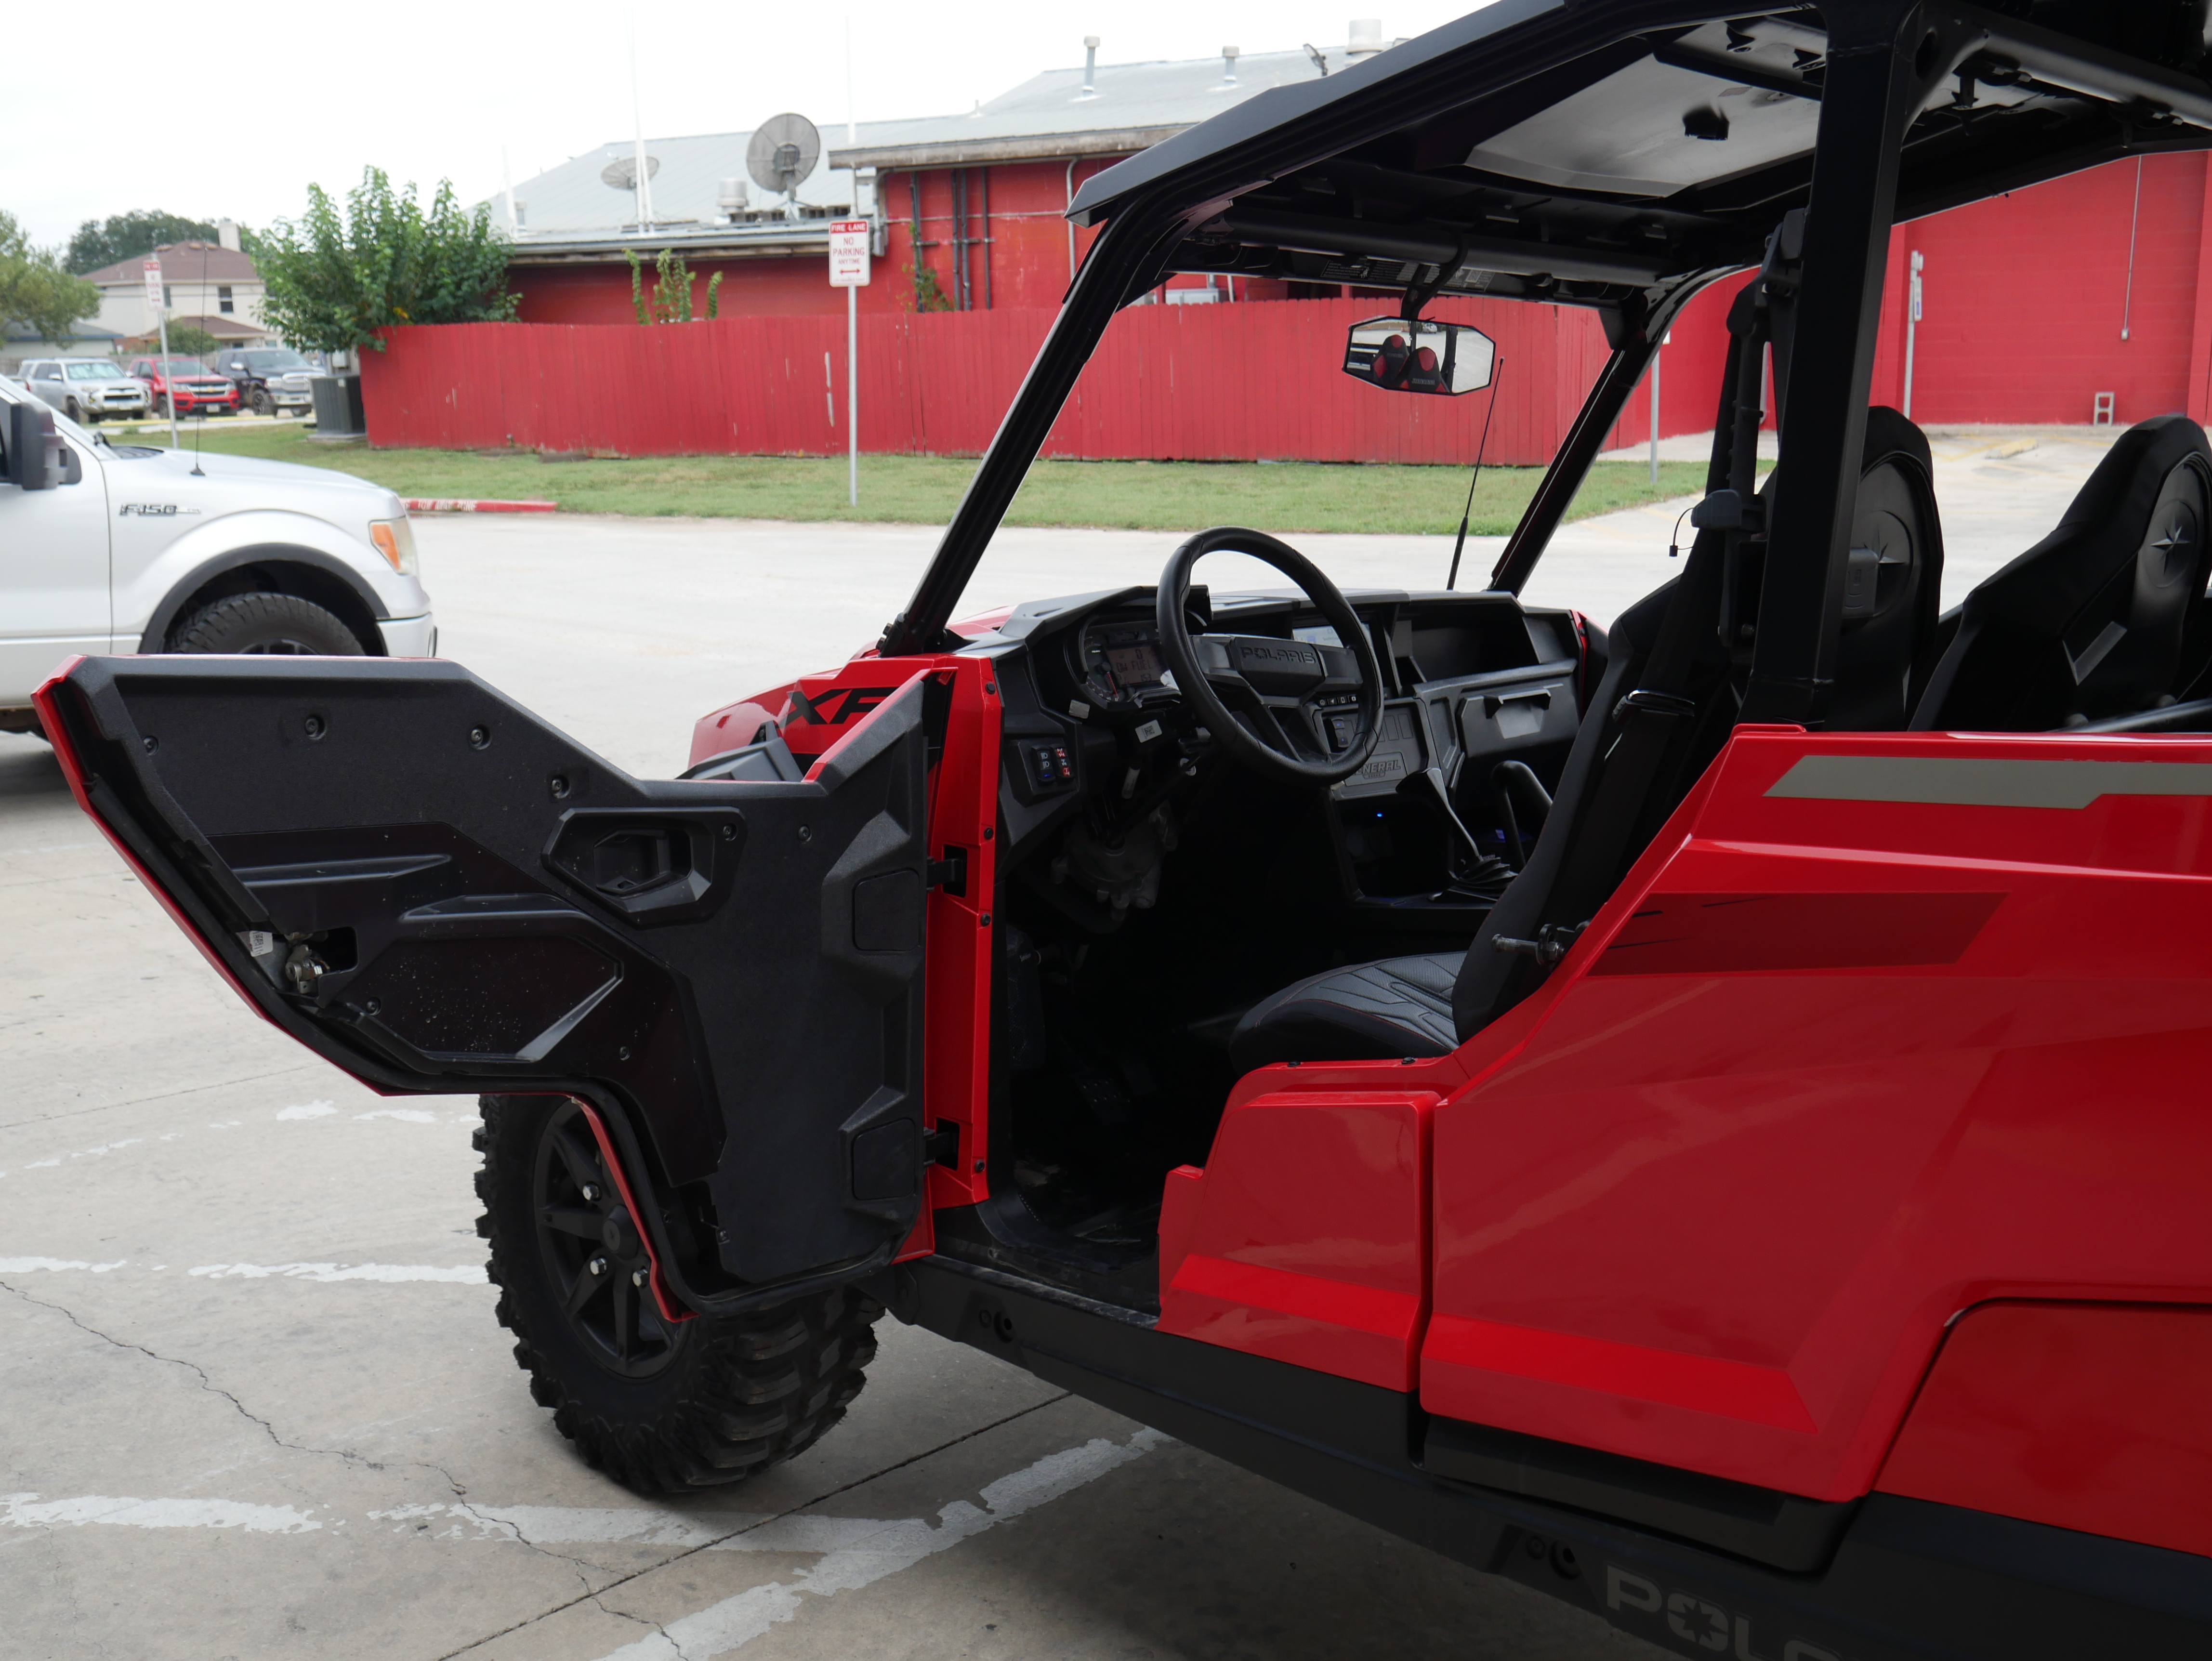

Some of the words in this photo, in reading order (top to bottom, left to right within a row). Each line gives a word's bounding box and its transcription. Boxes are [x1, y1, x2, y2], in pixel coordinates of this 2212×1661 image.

[831, 224, 845, 232] FIRE
[848, 223, 866, 231] LANE
[843, 237, 854, 245] NO
[833, 247, 865, 257] PARKING
[1240, 646, 1316, 664] POLARIS
